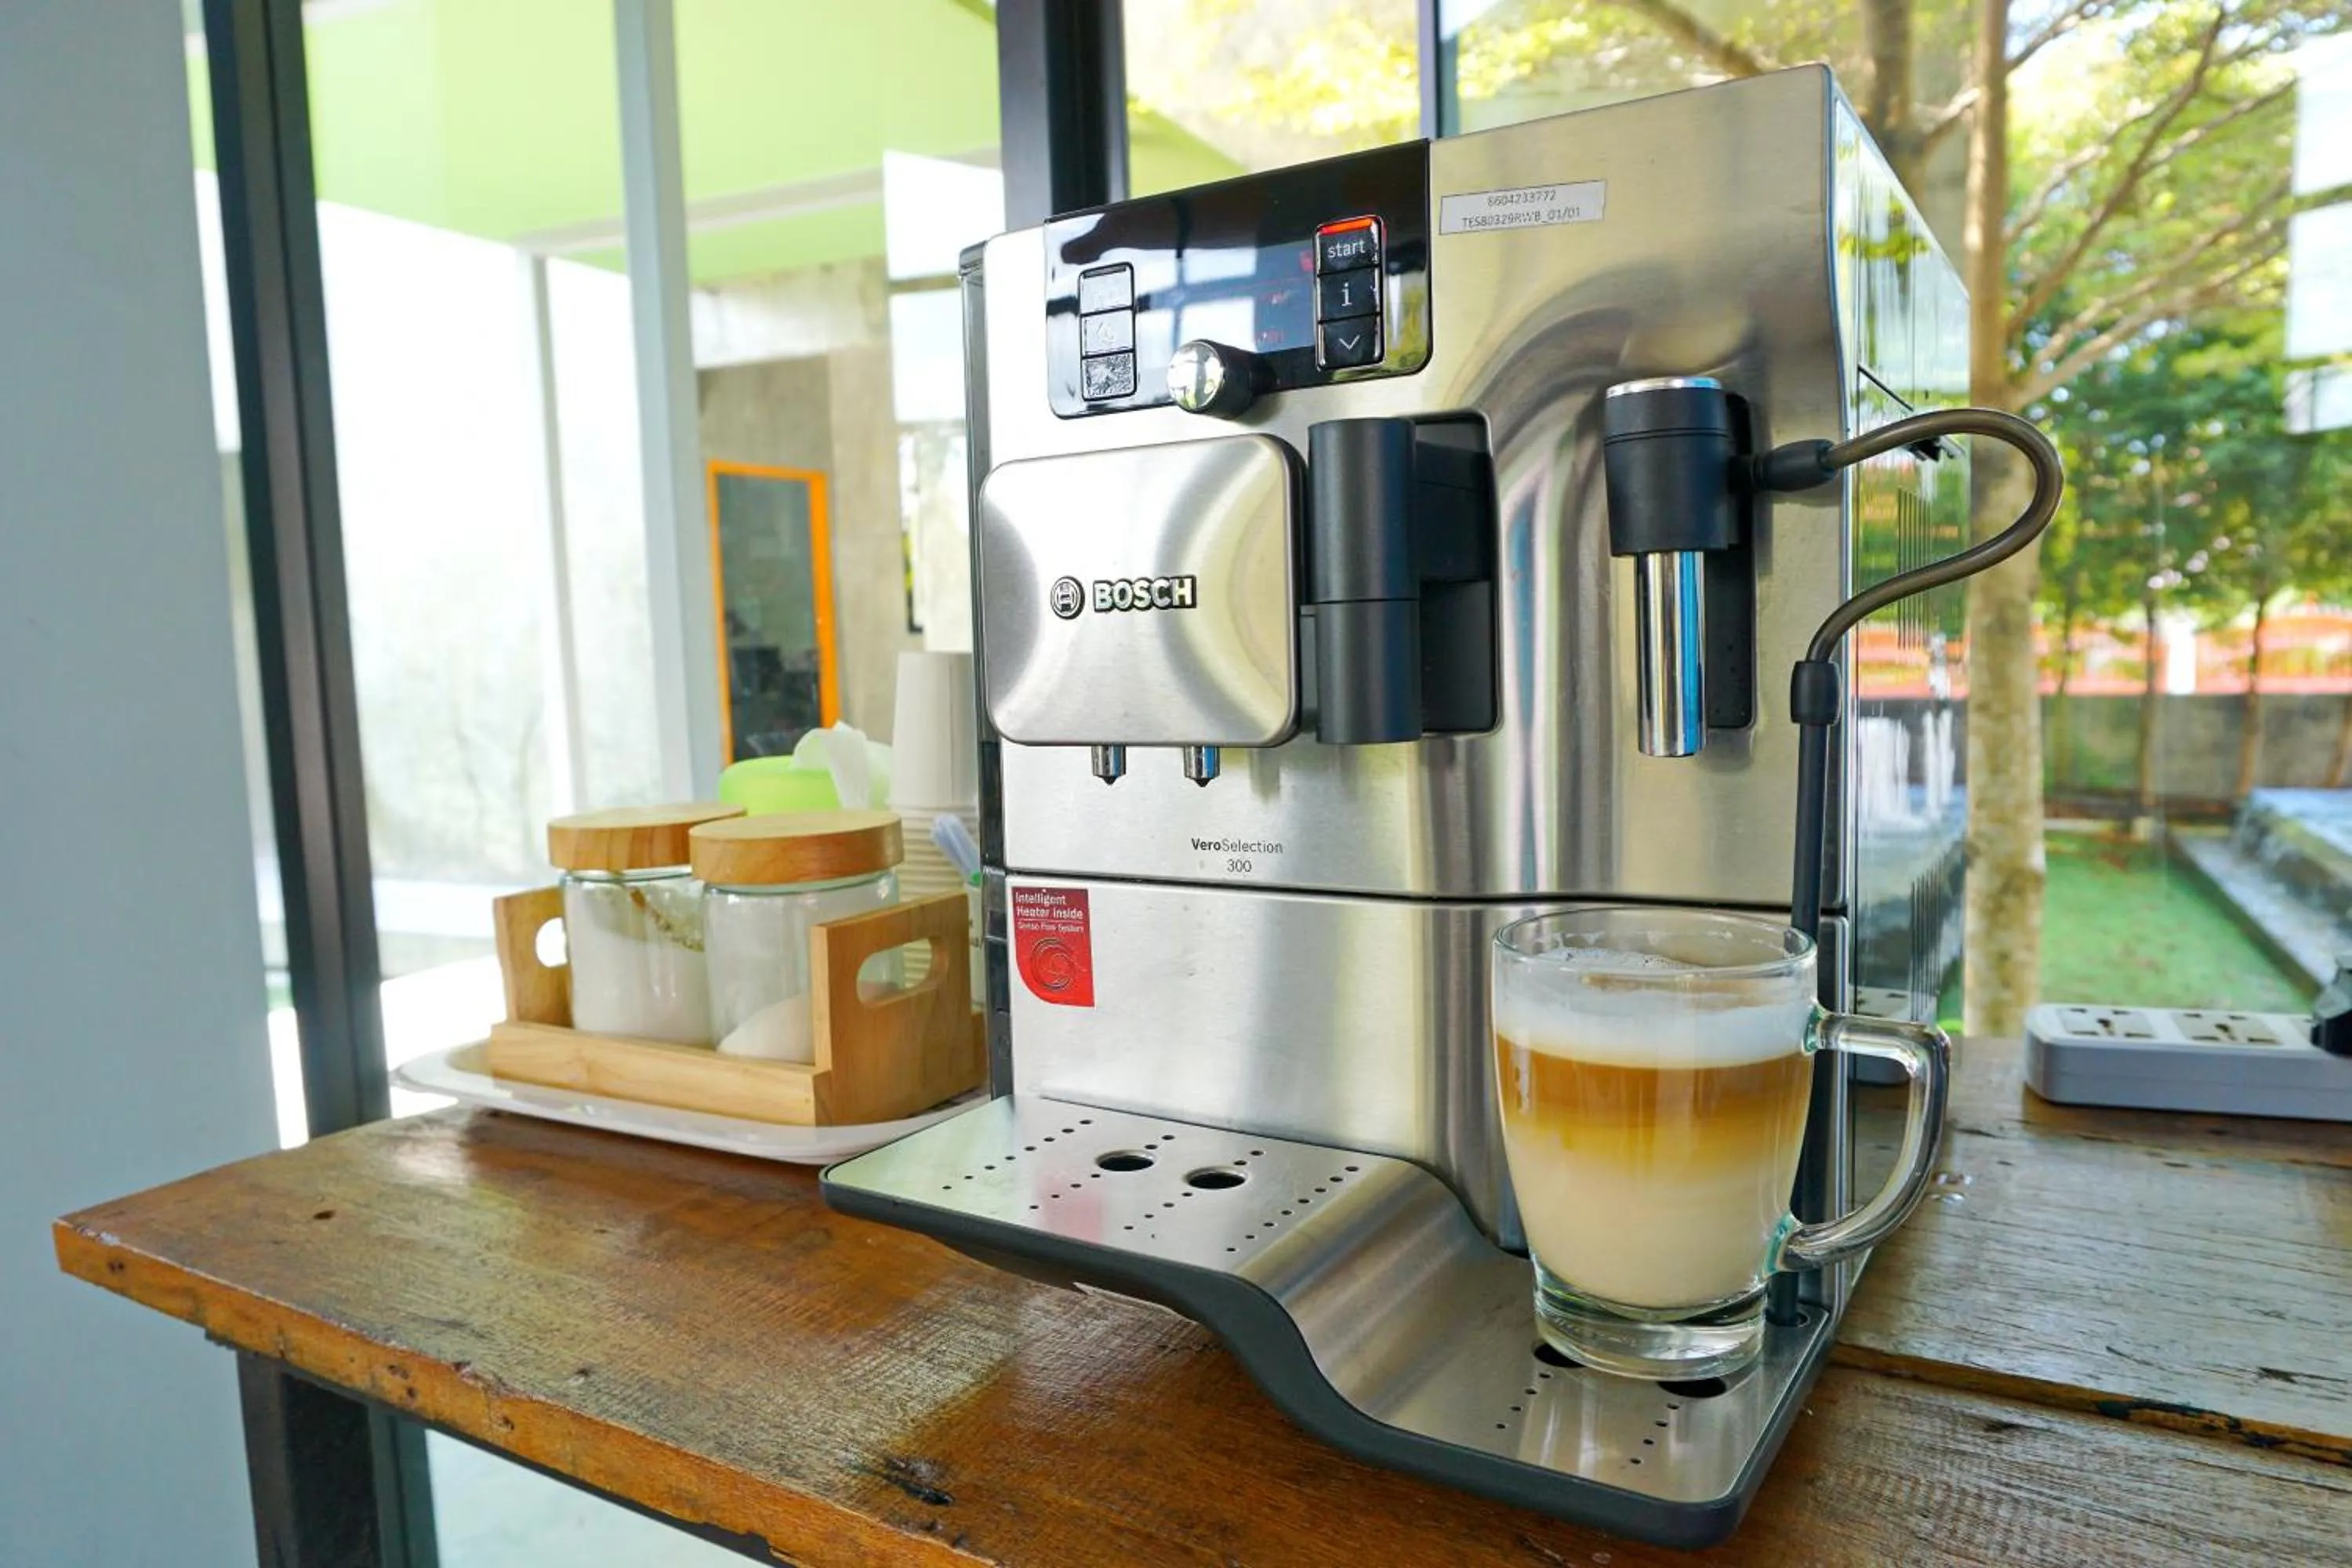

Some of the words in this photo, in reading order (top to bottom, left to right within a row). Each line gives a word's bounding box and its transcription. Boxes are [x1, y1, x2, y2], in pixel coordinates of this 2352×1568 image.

[1327, 238, 1366, 259] start
[1093, 575, 1197, 613] BOSCH
[1191, 837, 1283, 854] VeroSelection
[1227, 858, 1253, 873] 300
[1015, 889, 1067, 907] Intelligent
[1017, 906, 1050, 917] Heater
